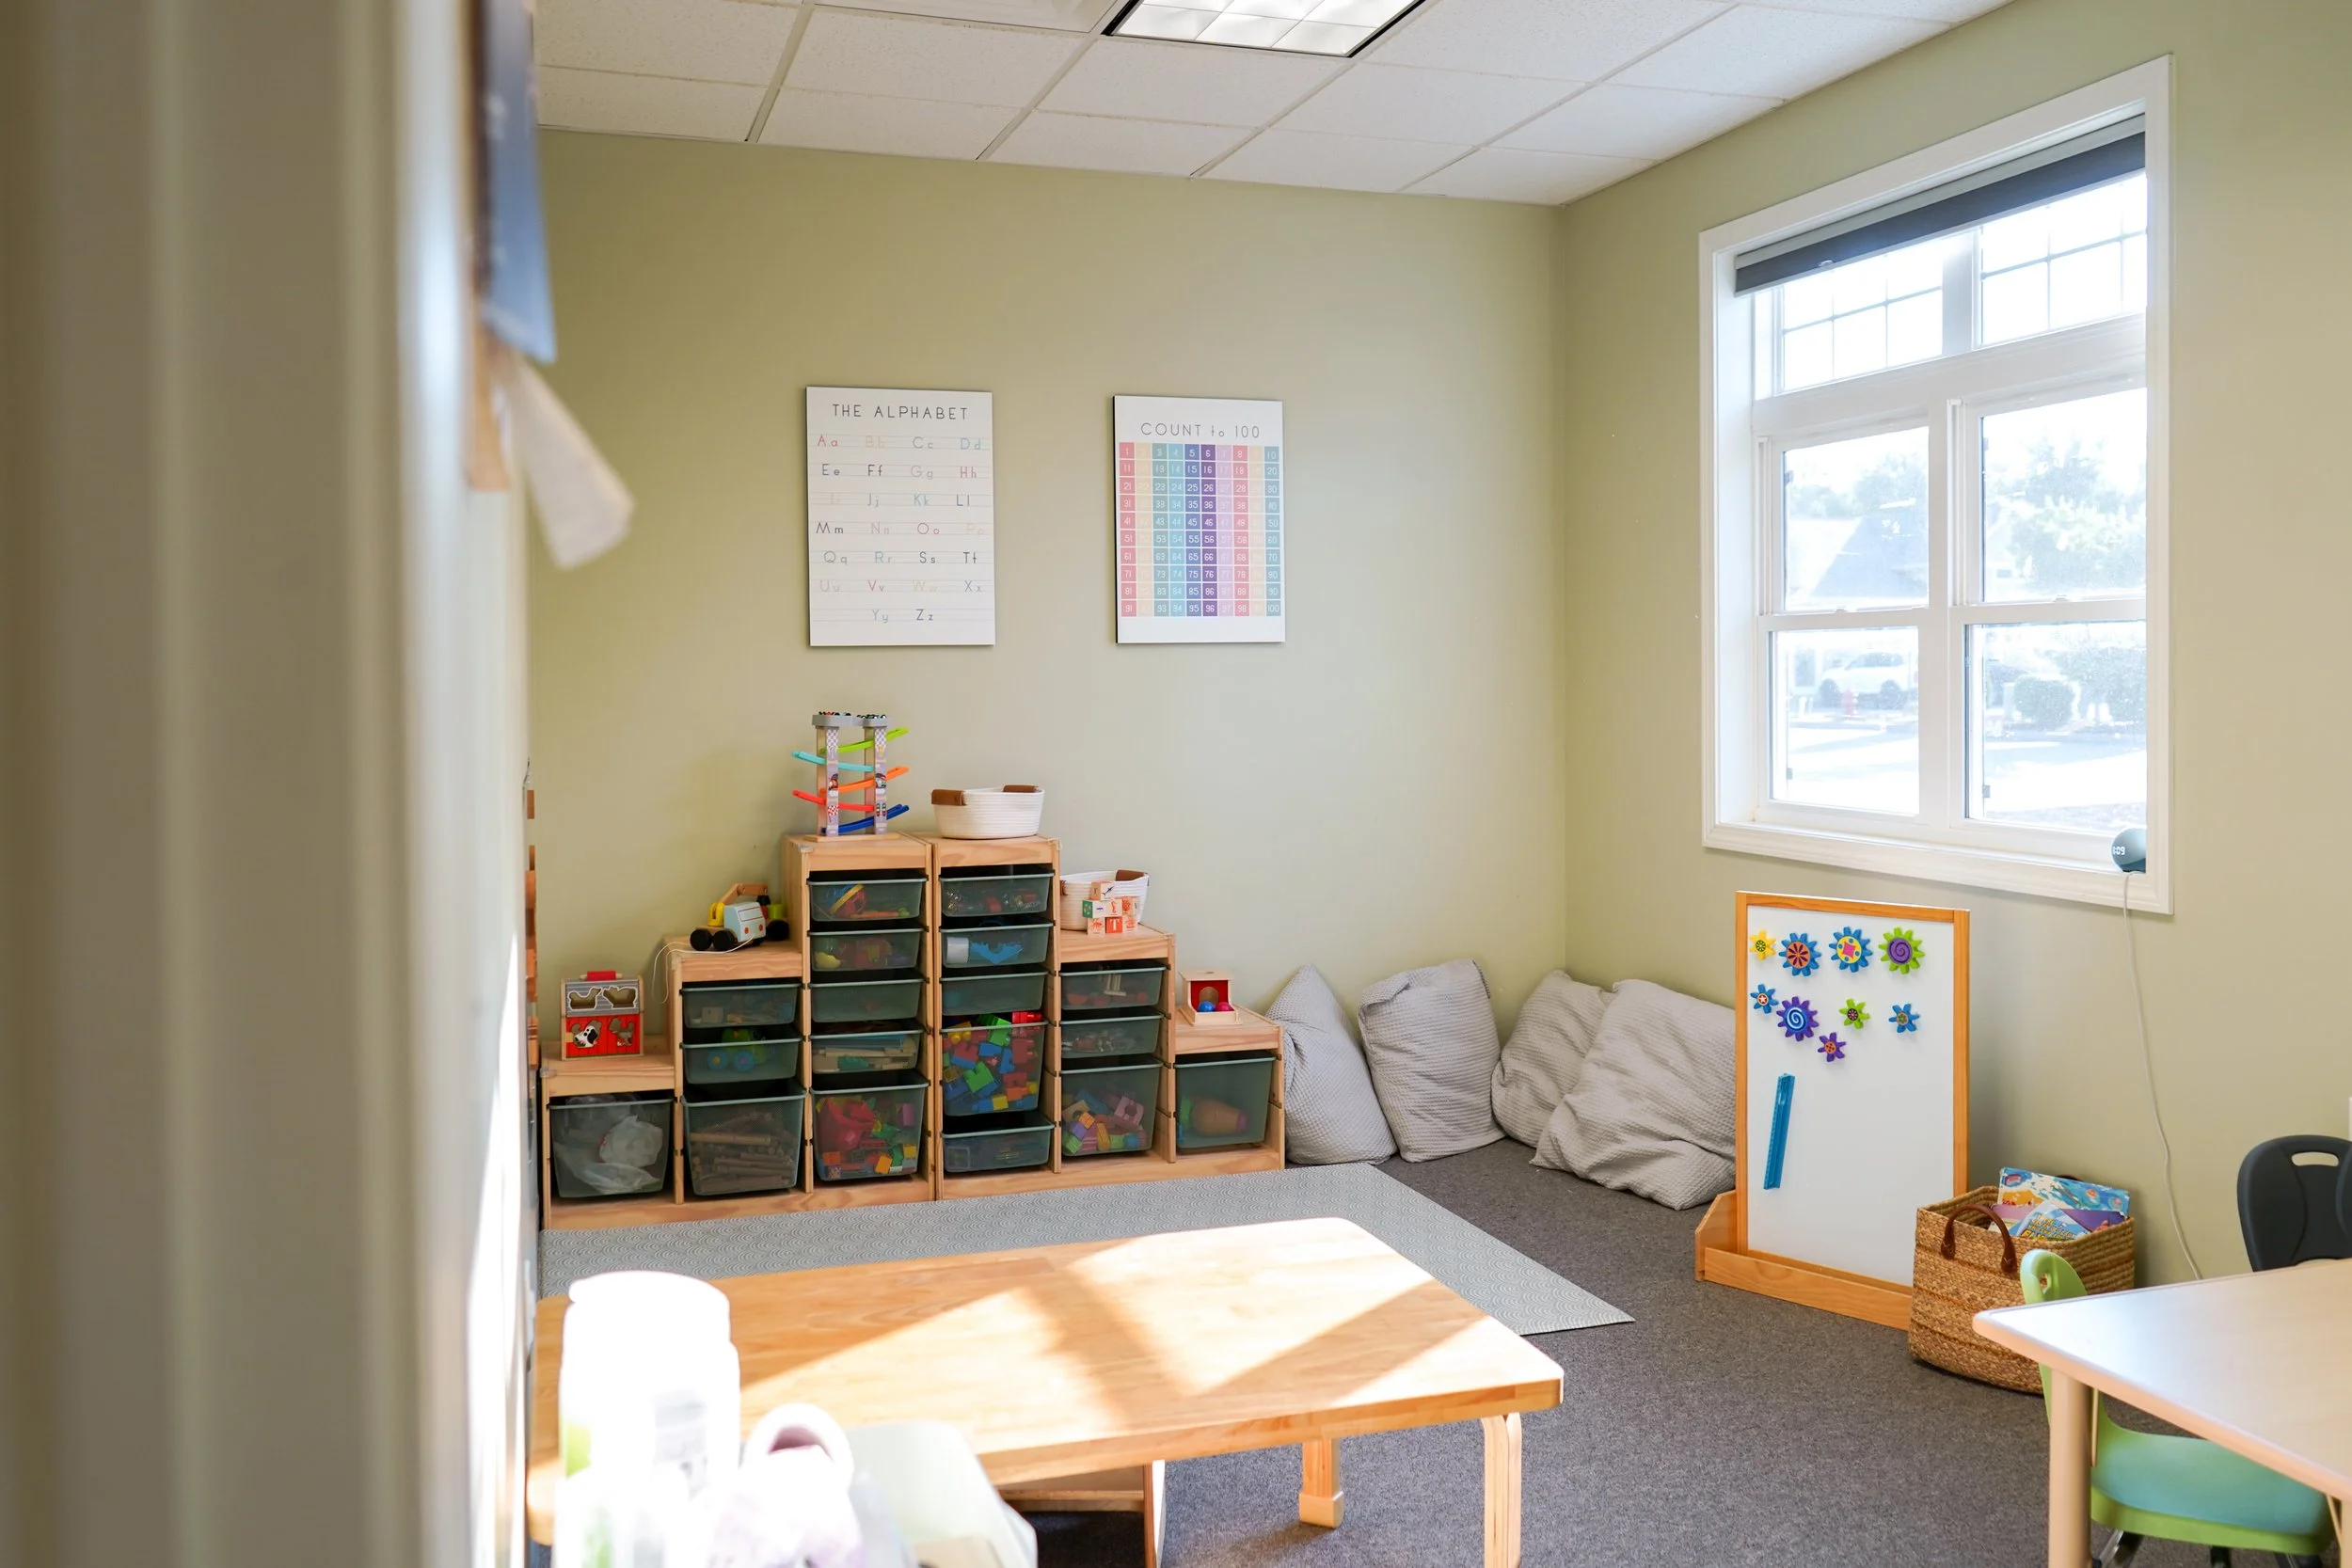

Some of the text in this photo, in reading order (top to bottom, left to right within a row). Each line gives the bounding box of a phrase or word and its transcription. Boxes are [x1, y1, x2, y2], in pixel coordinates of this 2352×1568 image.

[833, 404, 968, 420] THE ALPHABET
[1141, 422, 1260, 438] COUNT to 100
[818, 435, 838, 447] Aa
[913, 436, 934, 450] Cc
[961, 437, 981, 451] Dd
[1157, 449, 1162, 457] 3
[1189, 449, 1196, 458] 5
[1205, 450, 1211, 458] 6
[1267, 451, 1277, 460] 10
[822, 464, 977, 480] Ee Ff Gg Hh
[1155, 465, 1165, 473] 13
[1187, 466, 1198, 474] 15
[1203, 466, 1213, 474] 16
[1267, 467, 1278, 476] 20
[1154, 483, 1166, 492] 23
[1186, 483, 1199, 492] 25
[1203, 484, 1214, 493] 26
[1267, 485, 1278, 494] 30
[866, 493, 880, 507] Jj
[914, 494, 930, 506] Kk
[956, 495, 970, 507] Ll
[1155, 500, 1165, 509] 33
[1188, 500, 1199, 509] 35
[1203, 501, 1214, 510] 36
[1267, 501, 1278, 511] 40
[1155, 517, 1165, 526] 43
[1187, 518, 1198, 527] 45
[1204, 518, 1214, 527] 46
[1268, 519, 1279, 528] 50
[816, 522, 844, 534] Mm
[871, 522, 890, 534] Nn
[916, 522, 940, 535] Oo
[1156, 535, 1167, 544] 53
[1188, 535, 1200, 544] 55
[1204, 535, 1215, 544] 56
[1267, 536, 1278, 545] 60
[823, 550, 977, 565] Qq Rr Ss Tt
[1155, 553, 1166, 562] 63
[1188, 553, 1199, 562] 65
[1204, 553, 1214, 562] 66
[1268, 553, 1278, 562] 70
[1156, 570, 1166, 578] 73
[1189, 570, 1199, 578] 75
[1204, 570, 1215, 578] 76
[1267, 571, 1279, 579] 80
[867, 579, 884, 592] Vv
[964, 579, 982, 593] Xx
[1188, 587, 1200, 595] 85
[1205, 588, 1215, 596] 86
[1268, 587, 1279, 596] 90
[1157, 605, 1167, 613] 93
[1188, 604, 1200, 613] 95
[1205, 605, 1216, 613] 96
[1267, 604, 1280, 613] 100
[871, 609, 934, 623] Yy Zz
